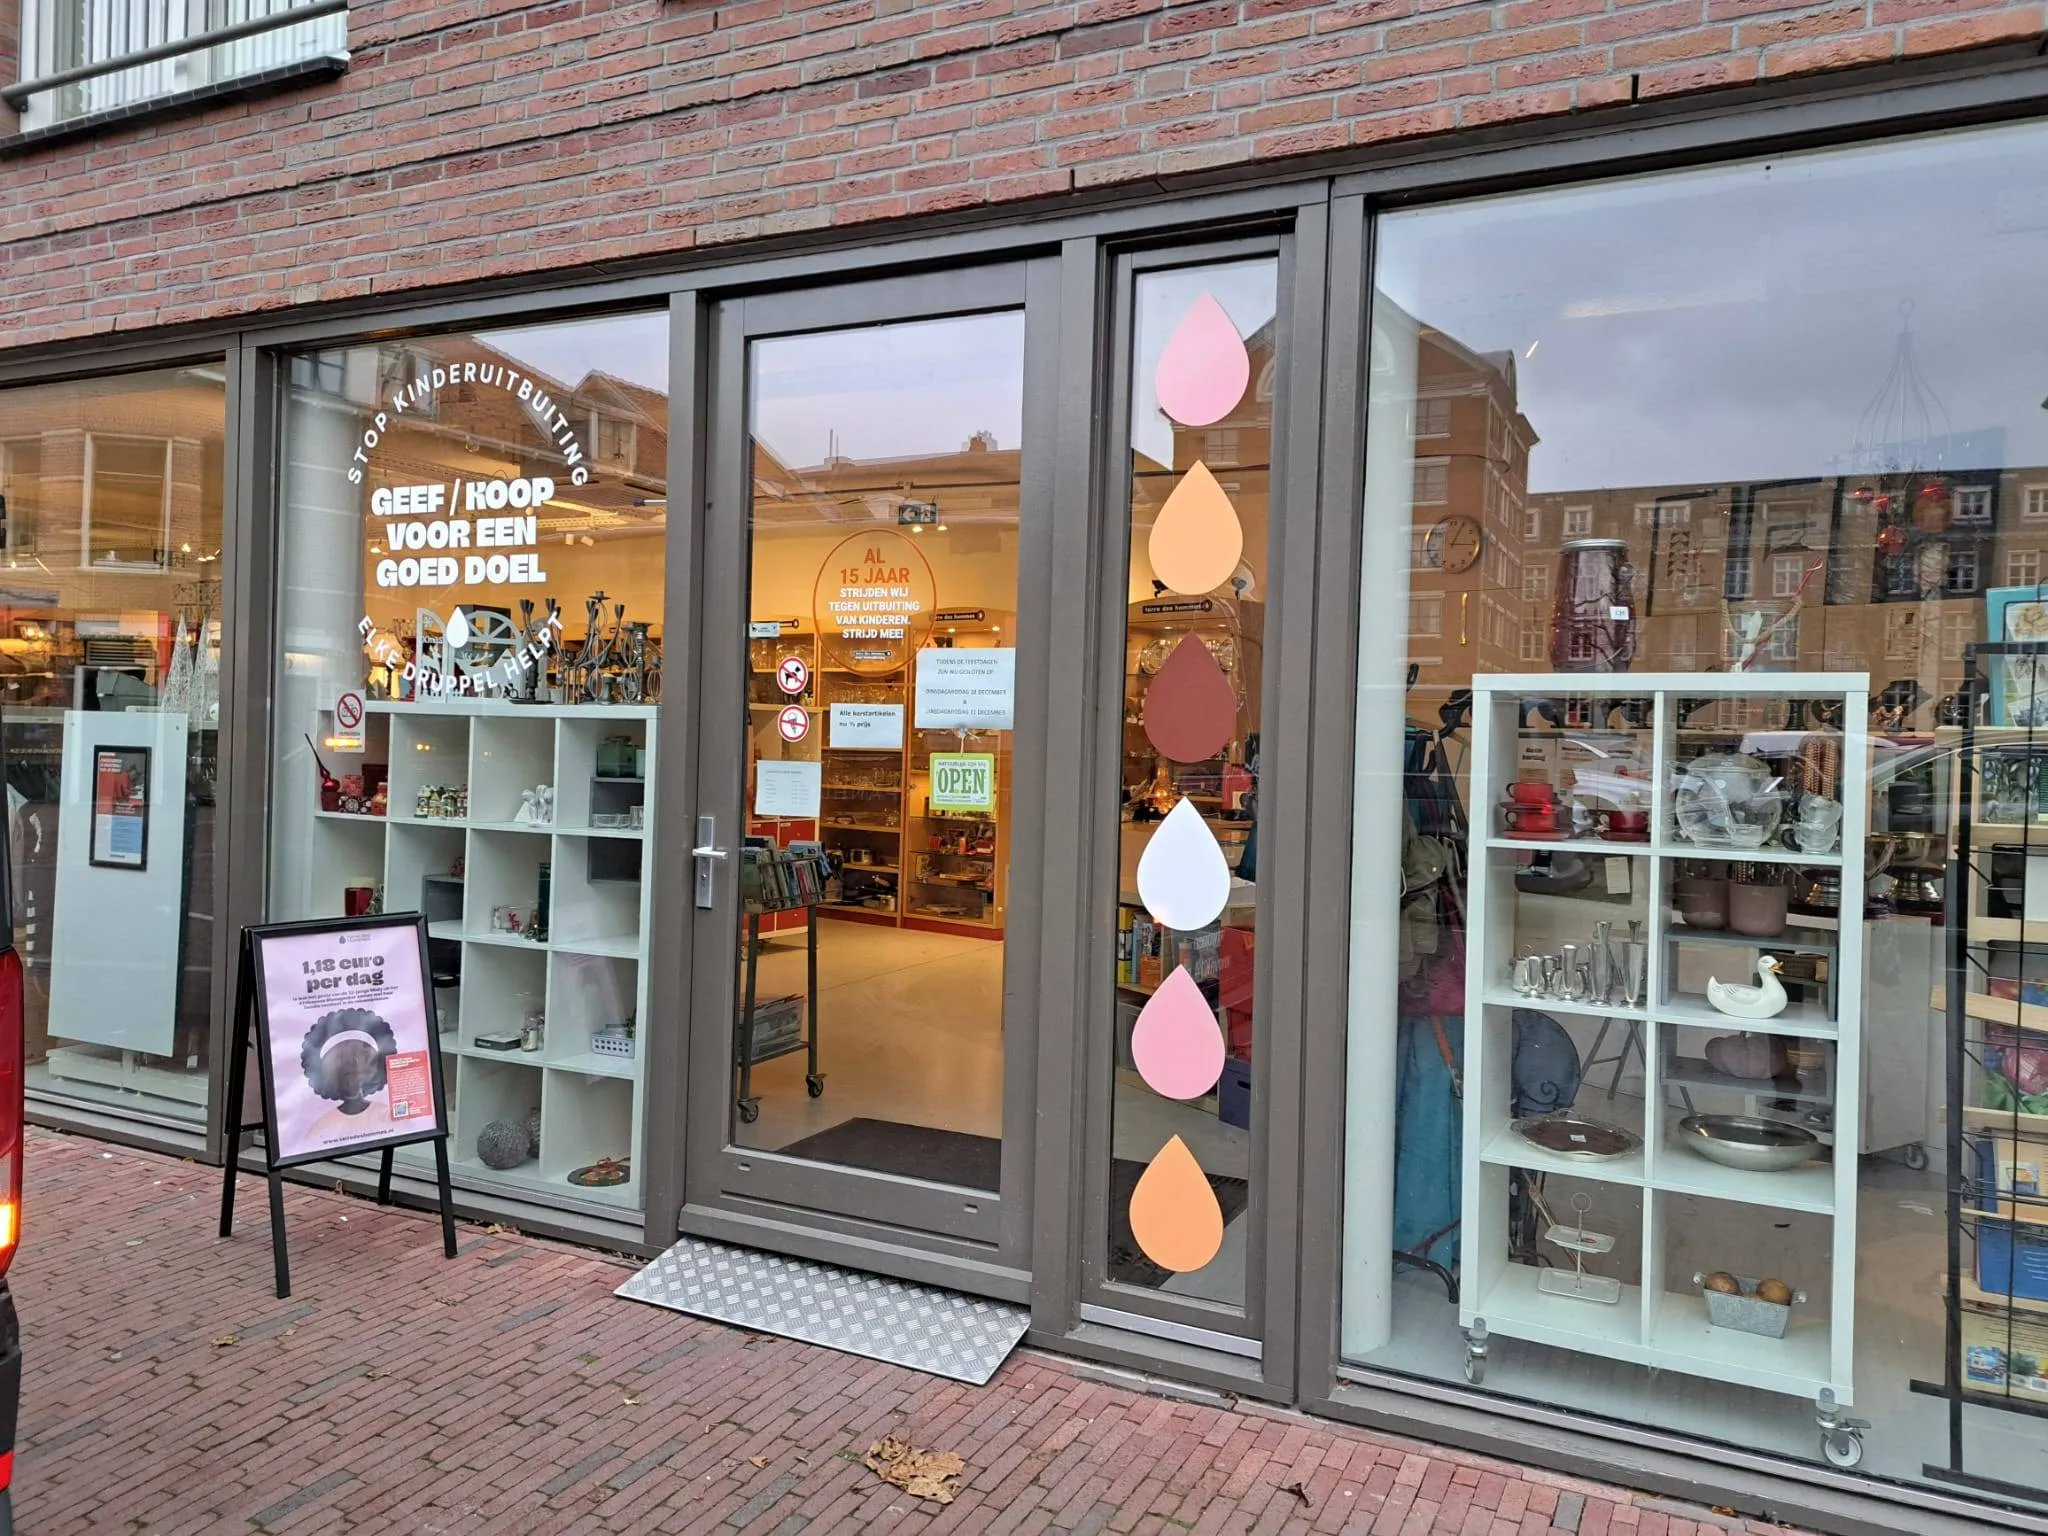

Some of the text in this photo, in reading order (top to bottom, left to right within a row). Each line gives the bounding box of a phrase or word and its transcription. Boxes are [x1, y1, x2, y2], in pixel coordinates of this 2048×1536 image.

[347, 362, 588, 487] STOP KINDERUITBUITING
[371, 484, 445, 516] GEEF
[465, 477, 555, 511] KOOP
[386, 516, 537, 551] VOOR EEN
[863, 548, 886, 564] AL
[376, 553, 547, 588] GOED DOEL
[840, 567, 910, 585] 15 JAAR
[840, 587, 909, 598] STRIJDEN WIJ
[828, 601, 920, 612] TEGEN UITBUITING
[836, 615, 911, 625] VAN KINDEREN.
[842, 629, 904, 639] STRIJD MEE!
[358, 611, 564, 694] ELKE DRUPPEL HELPT
[937, 768, 987, 794] OPEN
[302, 955, 385, 975] 1,18 euro
[306, 969, 385, 993] per dag
